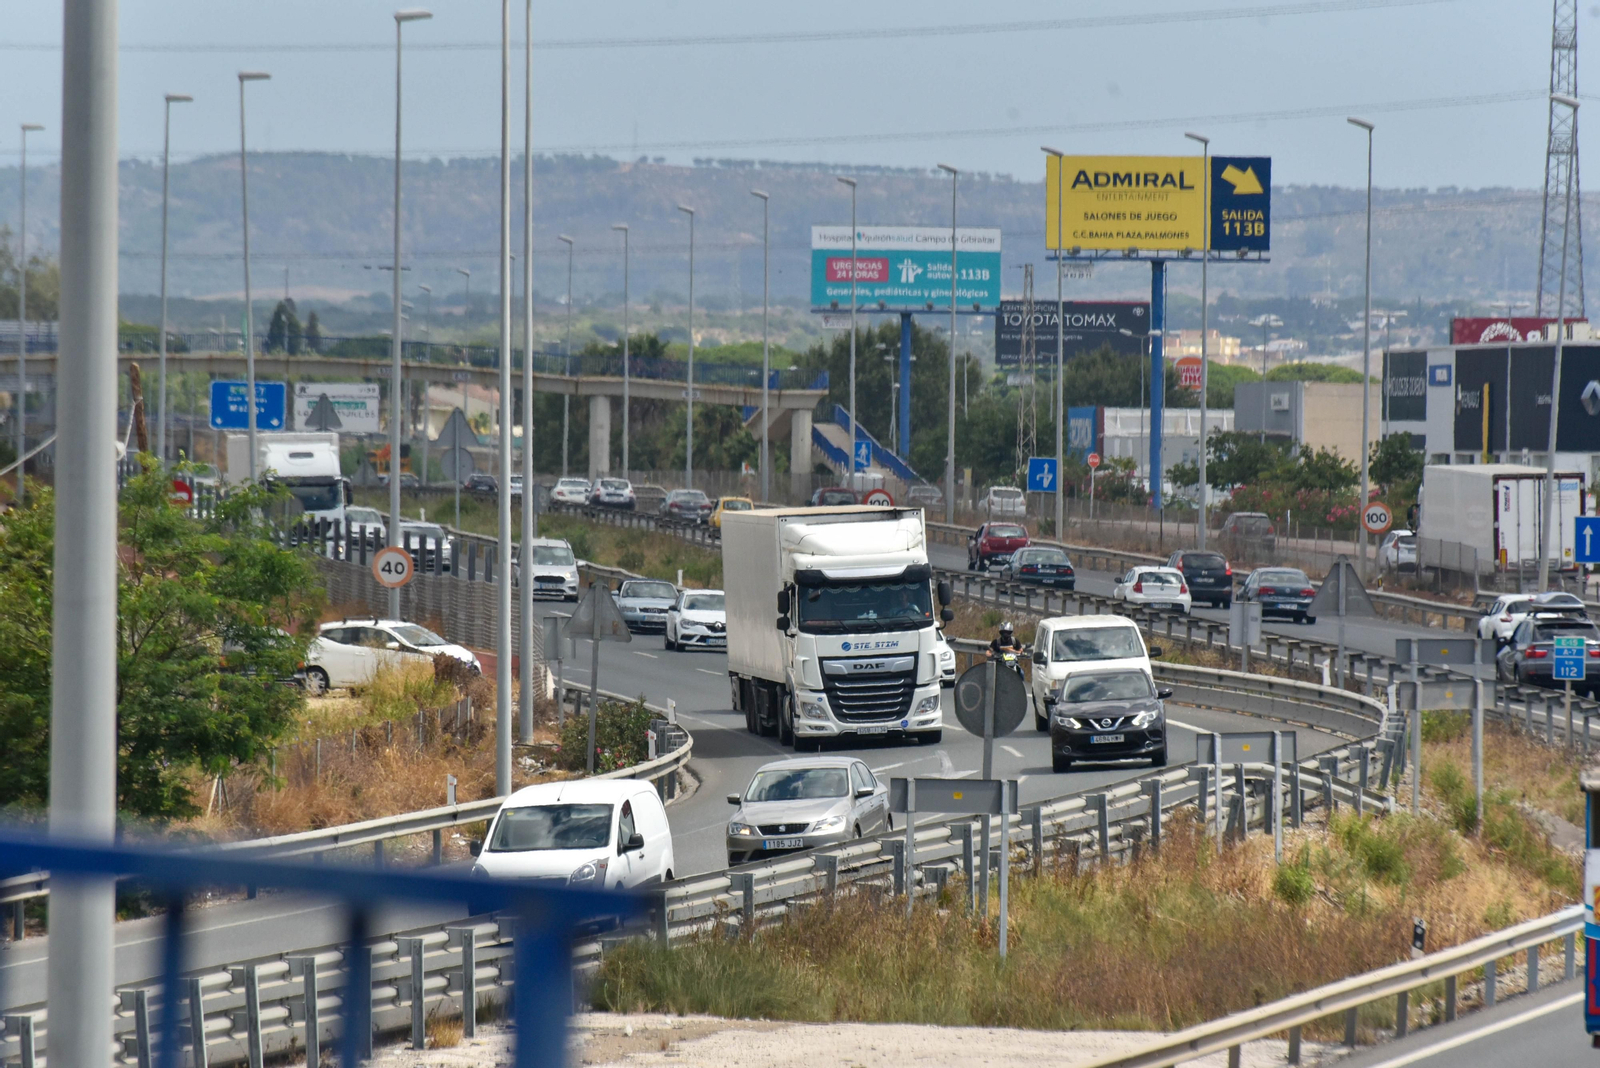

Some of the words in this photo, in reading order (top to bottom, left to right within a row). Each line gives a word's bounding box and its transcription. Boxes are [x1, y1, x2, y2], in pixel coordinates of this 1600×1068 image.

[1071, 170, 1195, 190] ADMIRAL
[1083, 211, 1127, 220] SALONES
[1129, 212, 1142, 220] DE
[1144, 212, 1178, 221] JUEGO
[1222, 209, 1264, 220] SALIDA
[1223, 221, 1265, 236] 113B
[819, 232, 853, 243] Hospita
[961, 235, 995, 244] Gibraltar
[832, 261, 882, 270] URGNCIAS
[836, 270, 846, 279] 24
[961, 268, 990, 281] 113B
[923, 289, 930, 298] y
[1002, 313, 1060, 326] TOYOTA
[1064, 313, 1117, 327] TOMAX
[1365, 512, 1387, 524] 100
[381, 560, 405, 575] 40
[853, 662, 886, 670] DAF
[1561, 667, 1577, 676] 112
[787, 839, 802, 847] JJZ
